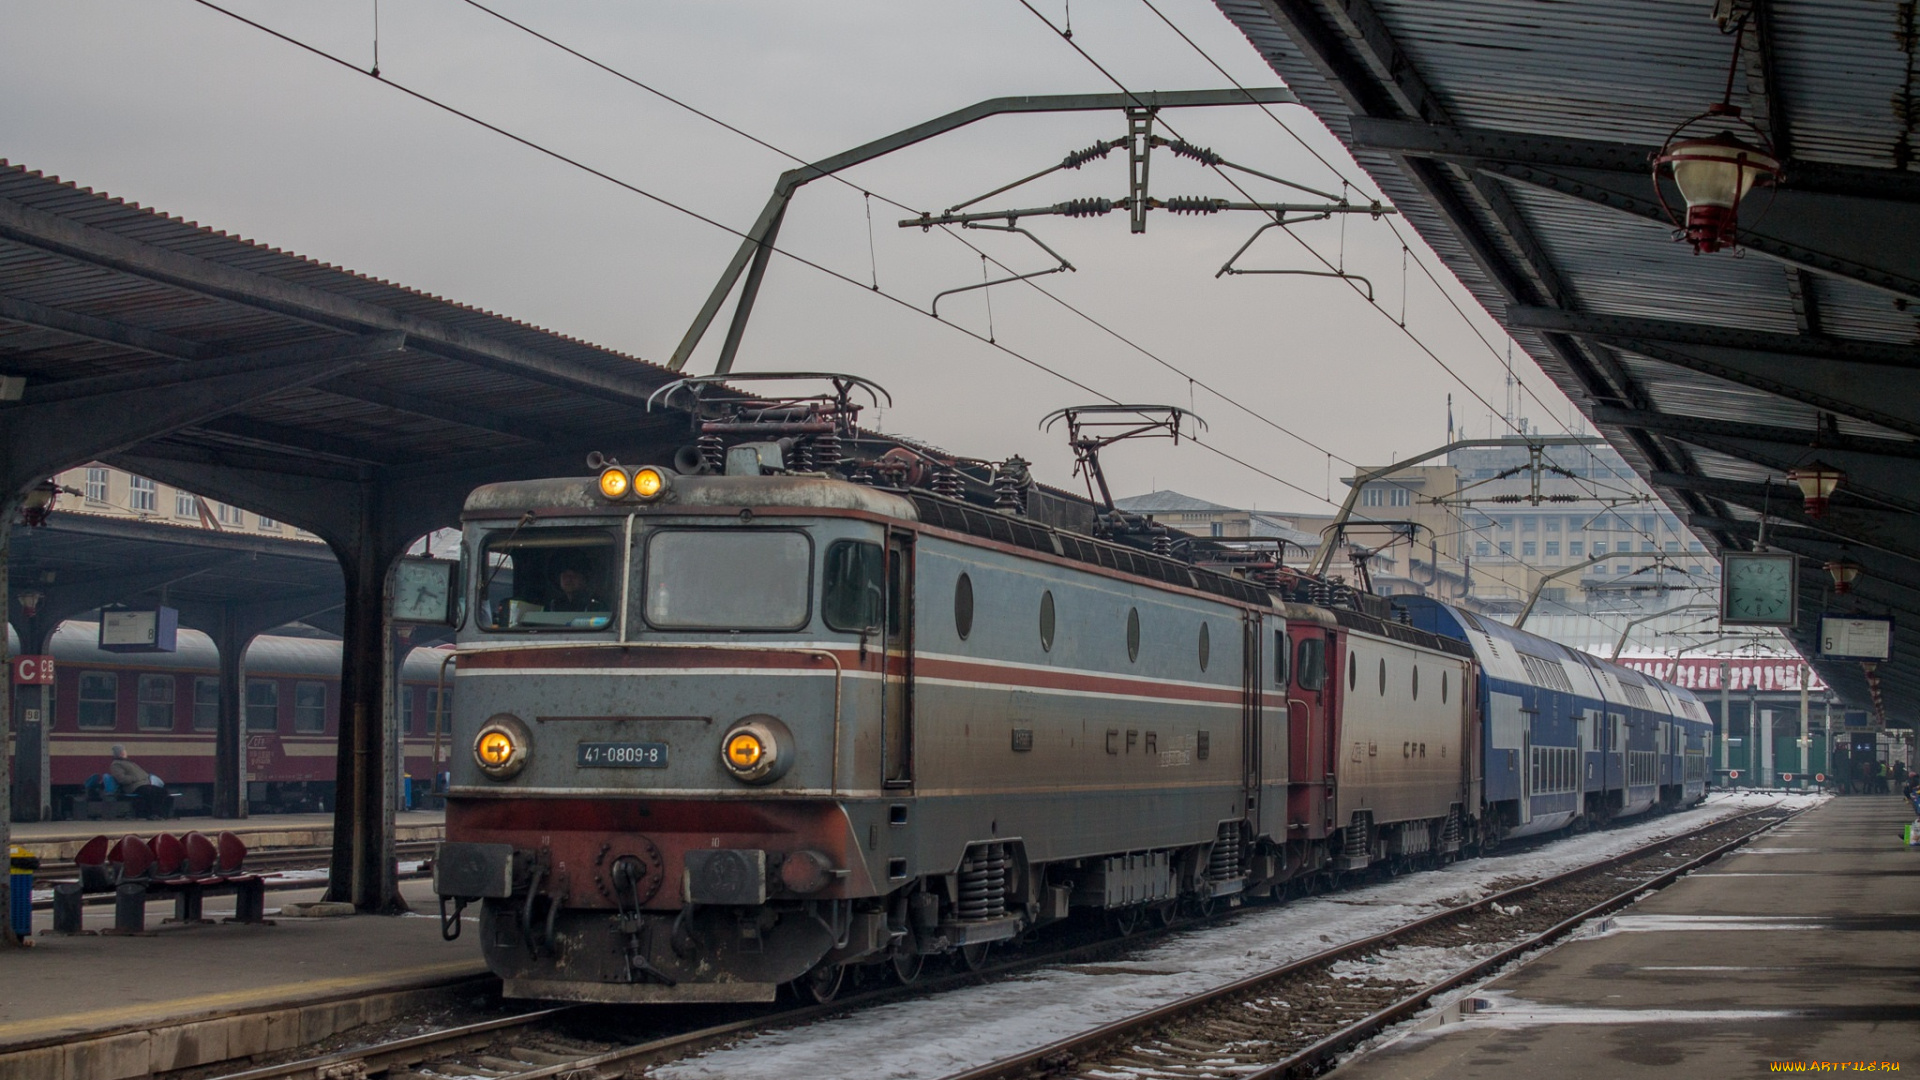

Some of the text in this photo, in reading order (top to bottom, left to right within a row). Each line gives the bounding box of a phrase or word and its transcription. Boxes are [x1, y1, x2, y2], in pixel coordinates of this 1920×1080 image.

[148, 628, 154, 640] 8
[1825, 637, 1833, 651] 5
[19, 659, 35, 680] C
[1106, 730, 1157, 756] CFR
[1403, 741, 1426, 759] CFR
[585, 747, 658, 762] 41-0809-8
